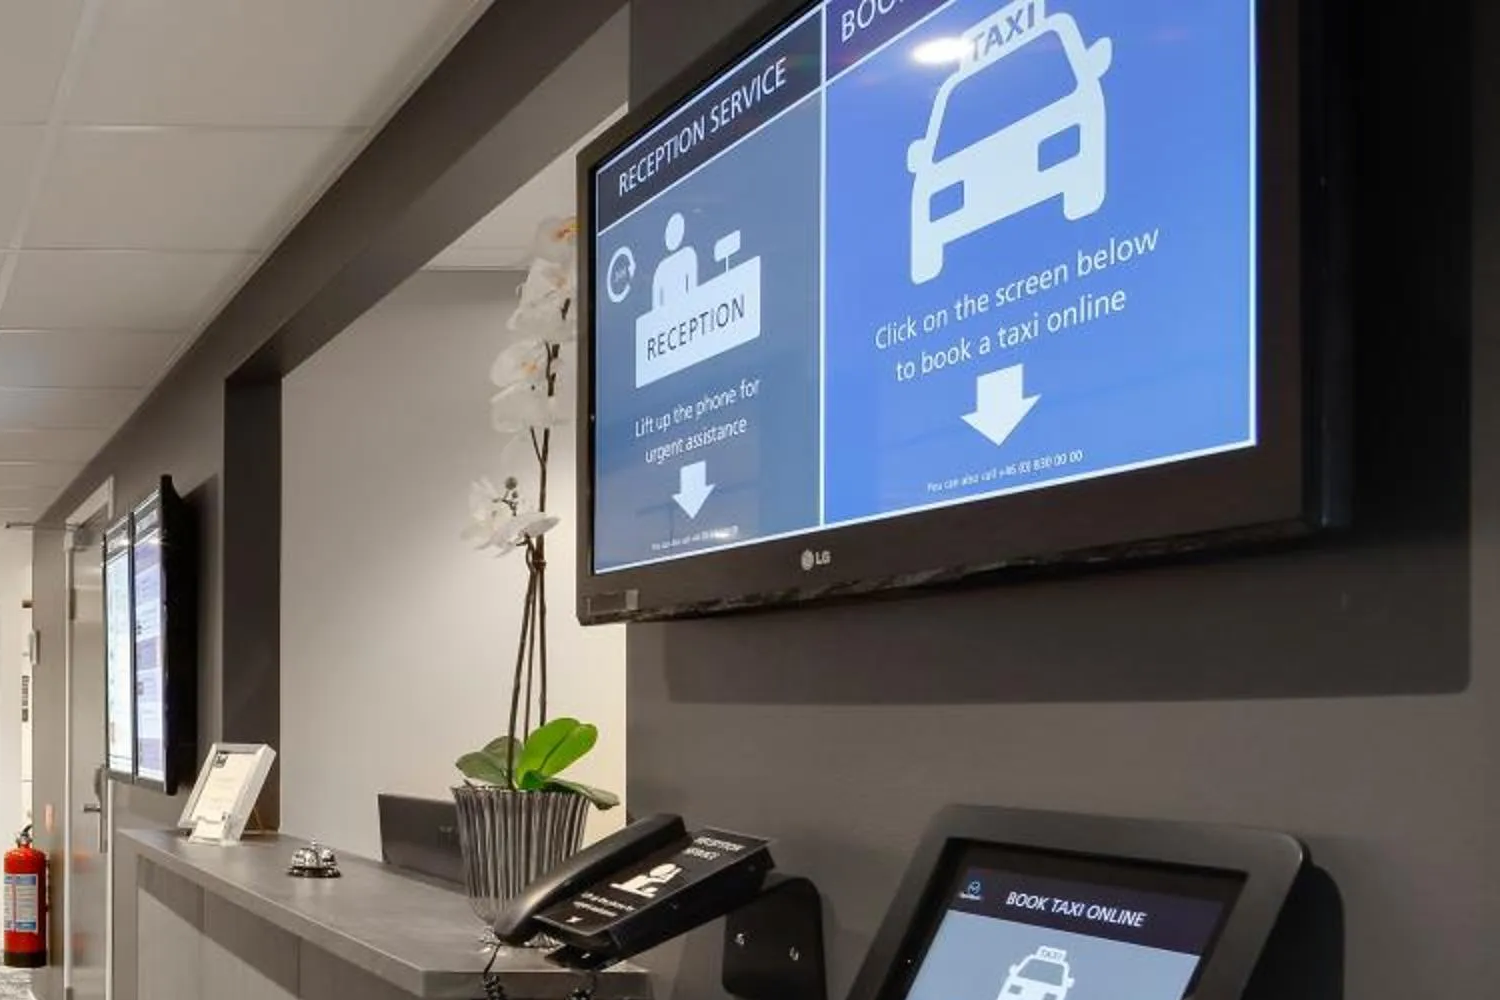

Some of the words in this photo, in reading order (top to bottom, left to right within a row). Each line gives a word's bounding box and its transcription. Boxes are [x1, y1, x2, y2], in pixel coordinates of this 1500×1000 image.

[971, 1, 1035, 62] TAXI
[619, 116, 705, 197] RECEPTION
[710, 56, 788, 133] SERVICE
[875, 315, 917, 349] Click
[923, 309, 948, 332] on
[954, 293, 989, 321] the
[995, 264, 1068, 307] screen
[1077, 228, 1159, 277] below
[647, 294, 744, 361] RECEPTION
[896, 362, 915, 381] to
[921, 337, 971, 375] book
[979, 336, 990, 355] a
[997, 312, 1039, 348] taxi
[1047, 289, 1126, 333] online
[635, 416, 653, 437] Lift
[656, 414, 671, 433] up
[674, 404, 693, 424] the
[695, 389, 736, 420] phone
[740, 379, 760, 399] for
[645, 439, 684, 465] urgent
[685, 418, 747, 451] assistance
[815, 551, 831, 565] LG
[1006, 891, 1049, 911] BOOK
[1050, 898, 1084, 917] TAXI
[1087, 905, 1148, 927] ONLINE
